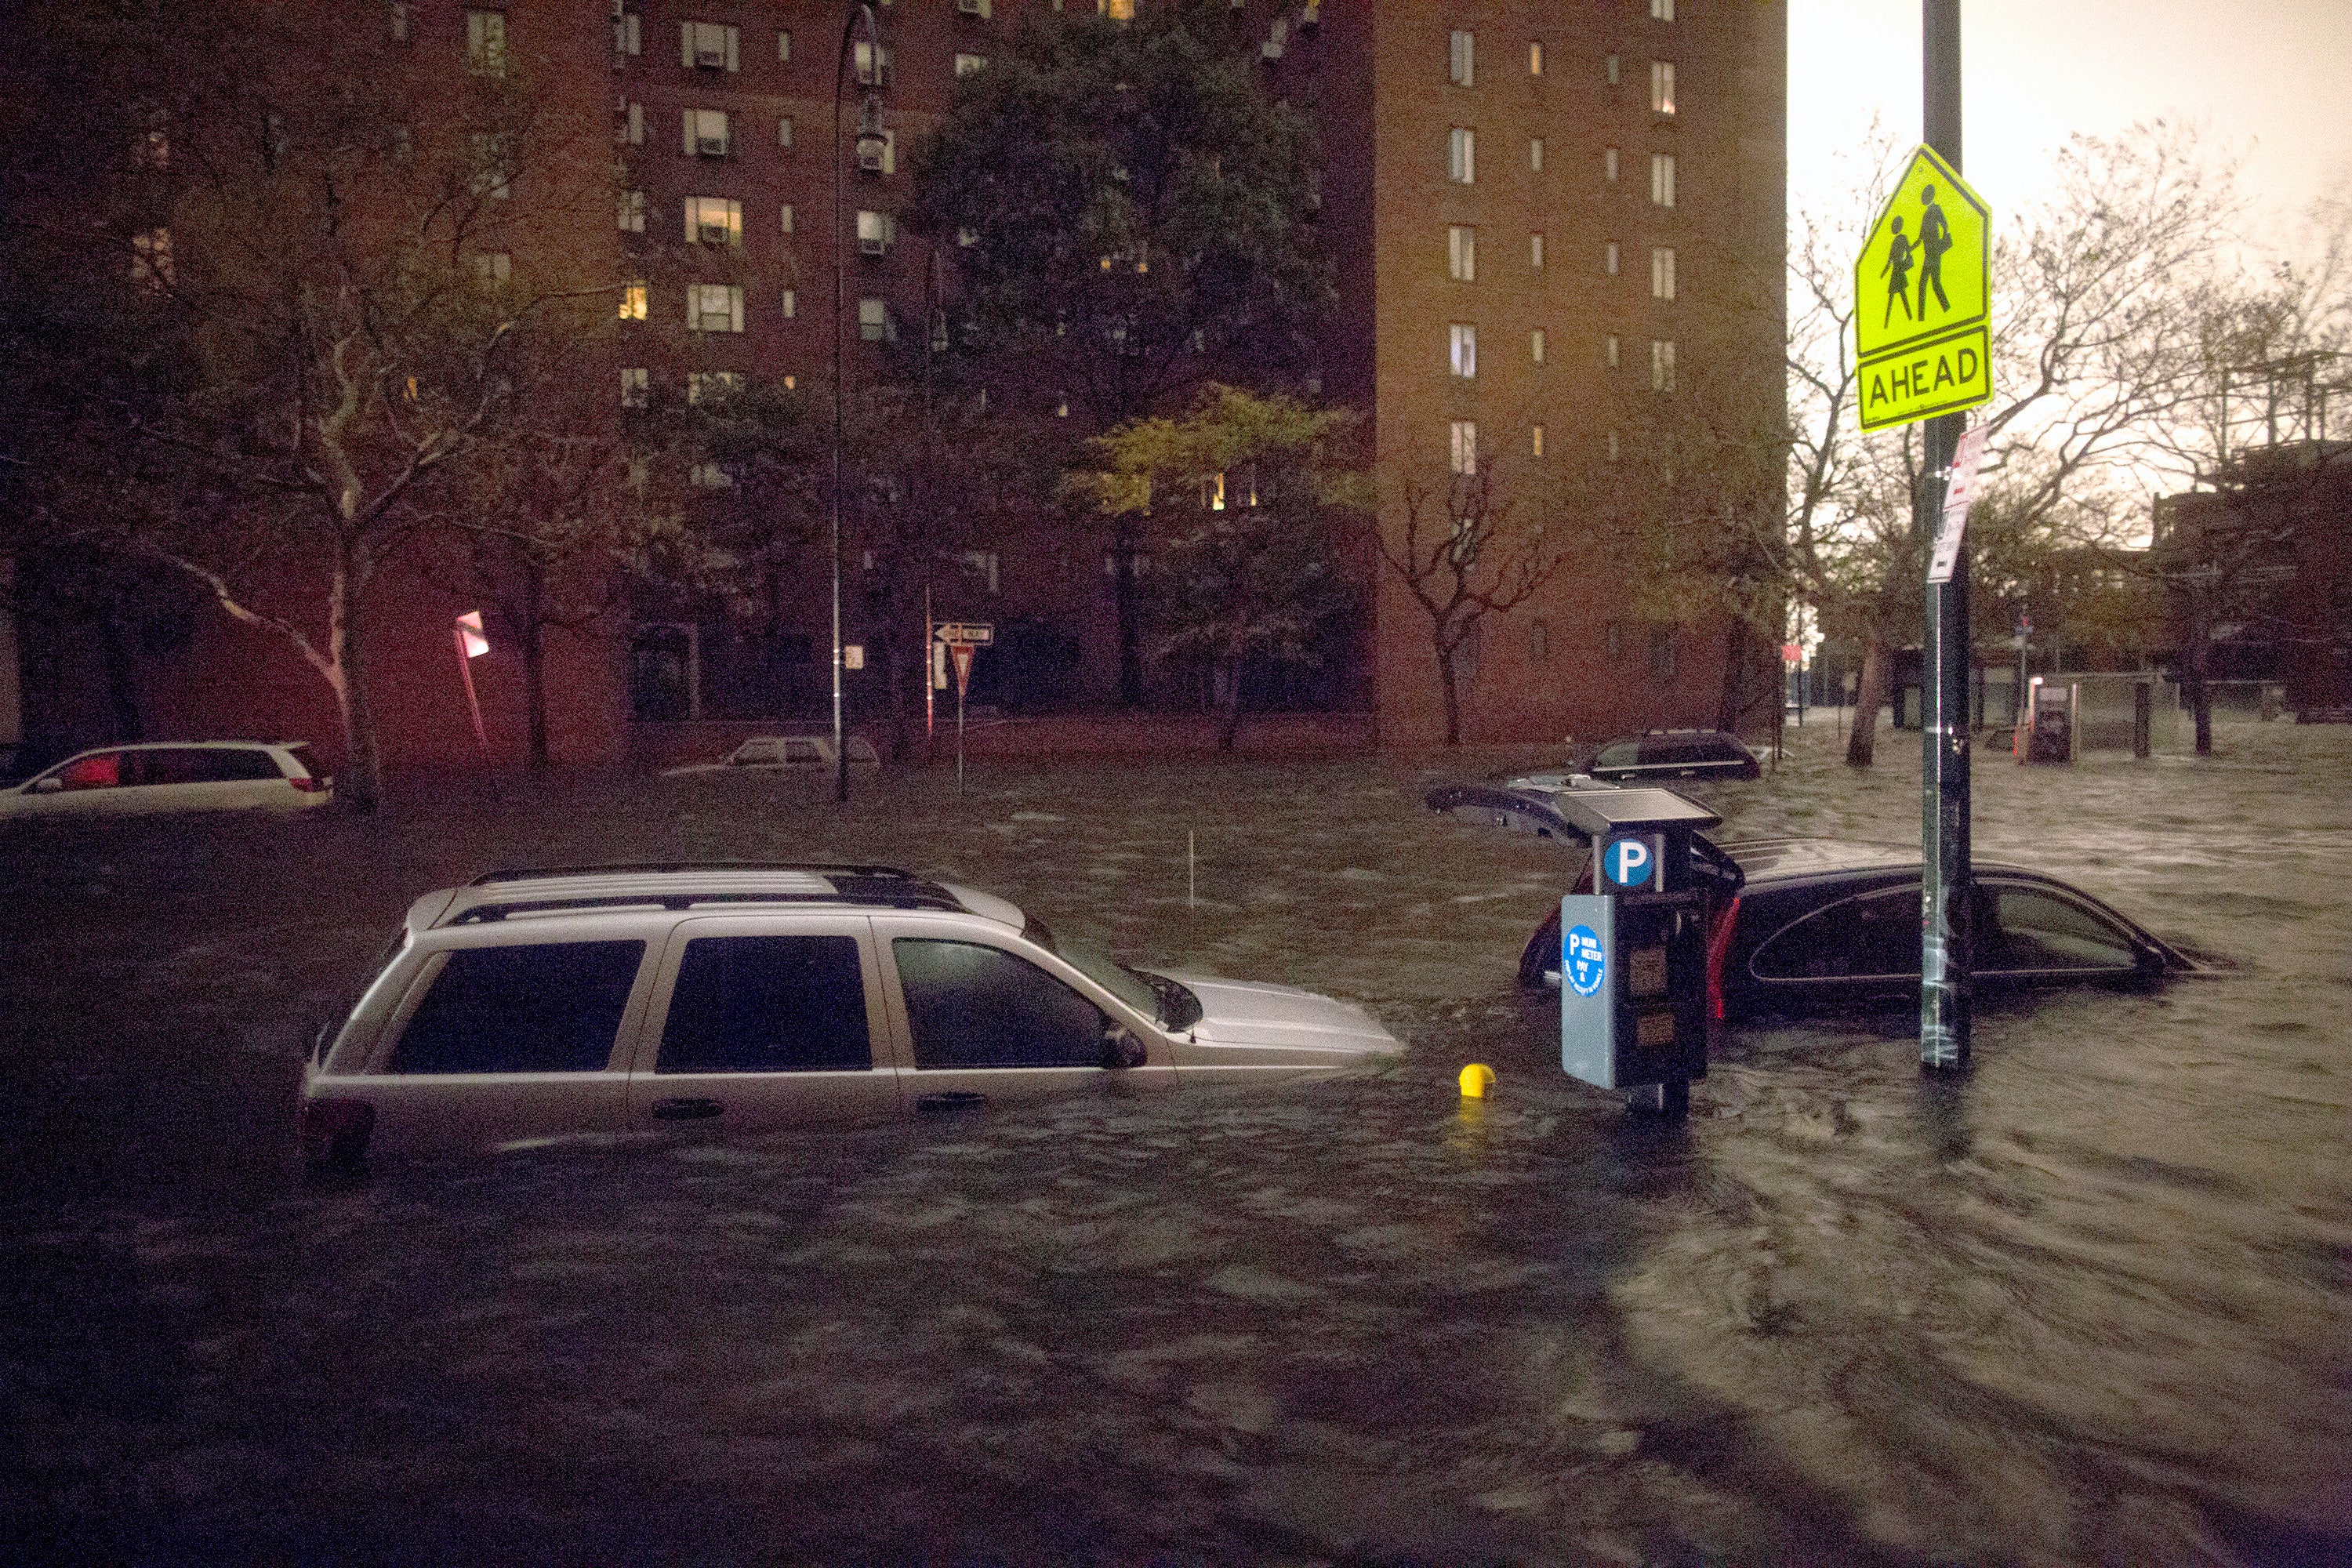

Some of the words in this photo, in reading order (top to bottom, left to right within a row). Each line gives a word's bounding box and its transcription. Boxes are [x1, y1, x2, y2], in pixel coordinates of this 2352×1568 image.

[1869, 347, 1978, 408] AHEAD
[1620, 842, 1647, 883] P
[1570, 934, 1580, 956] P
[1581, 948, 1602, 962] METER
[1577, 960, 1588, 972] PAY
